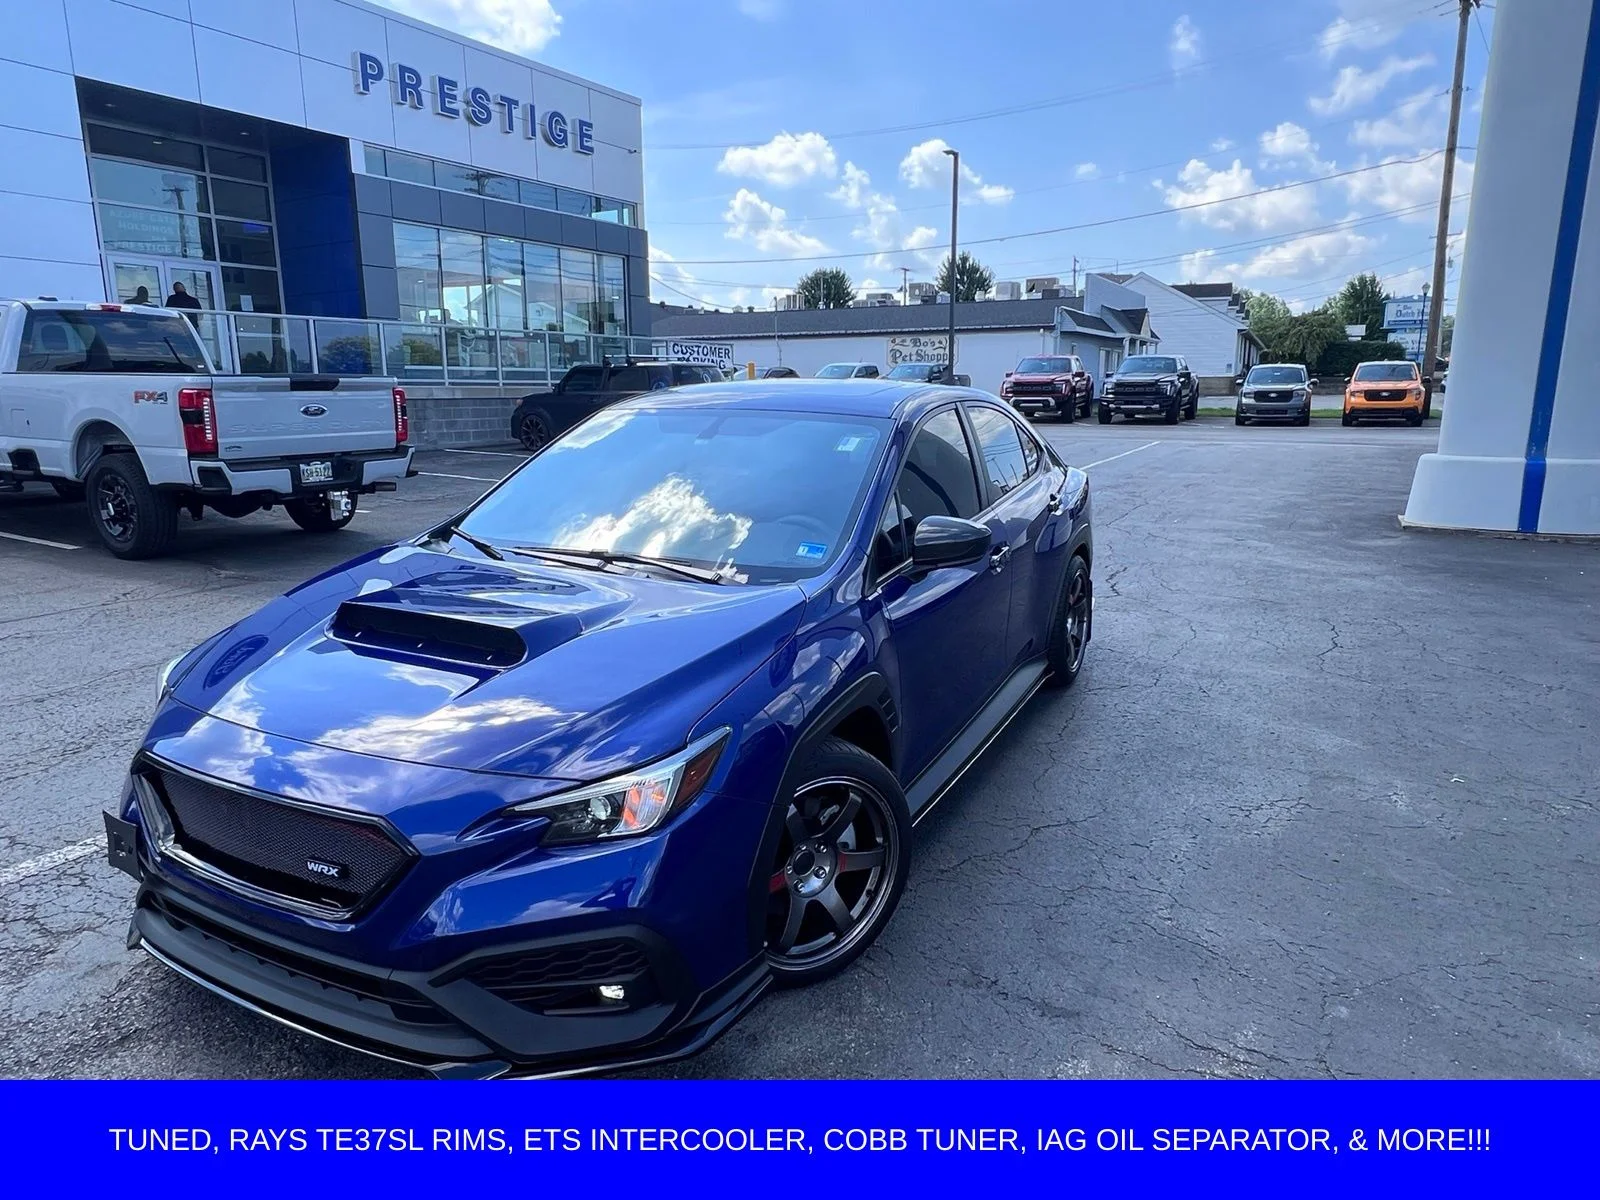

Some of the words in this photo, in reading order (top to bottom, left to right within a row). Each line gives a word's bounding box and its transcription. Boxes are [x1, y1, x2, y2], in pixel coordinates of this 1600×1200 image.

[353, 51, 595, 155] PRESTIGE
[910, 338, 936, 348] Bo's
[672, 343, 731, 360] CUSTOMER
[889, 348, 913, 364] Pet
[915, 348, 949, 364] Shopp
[133, 390, 169, 404] FX4
[307, 861, 339, 877] WRX
